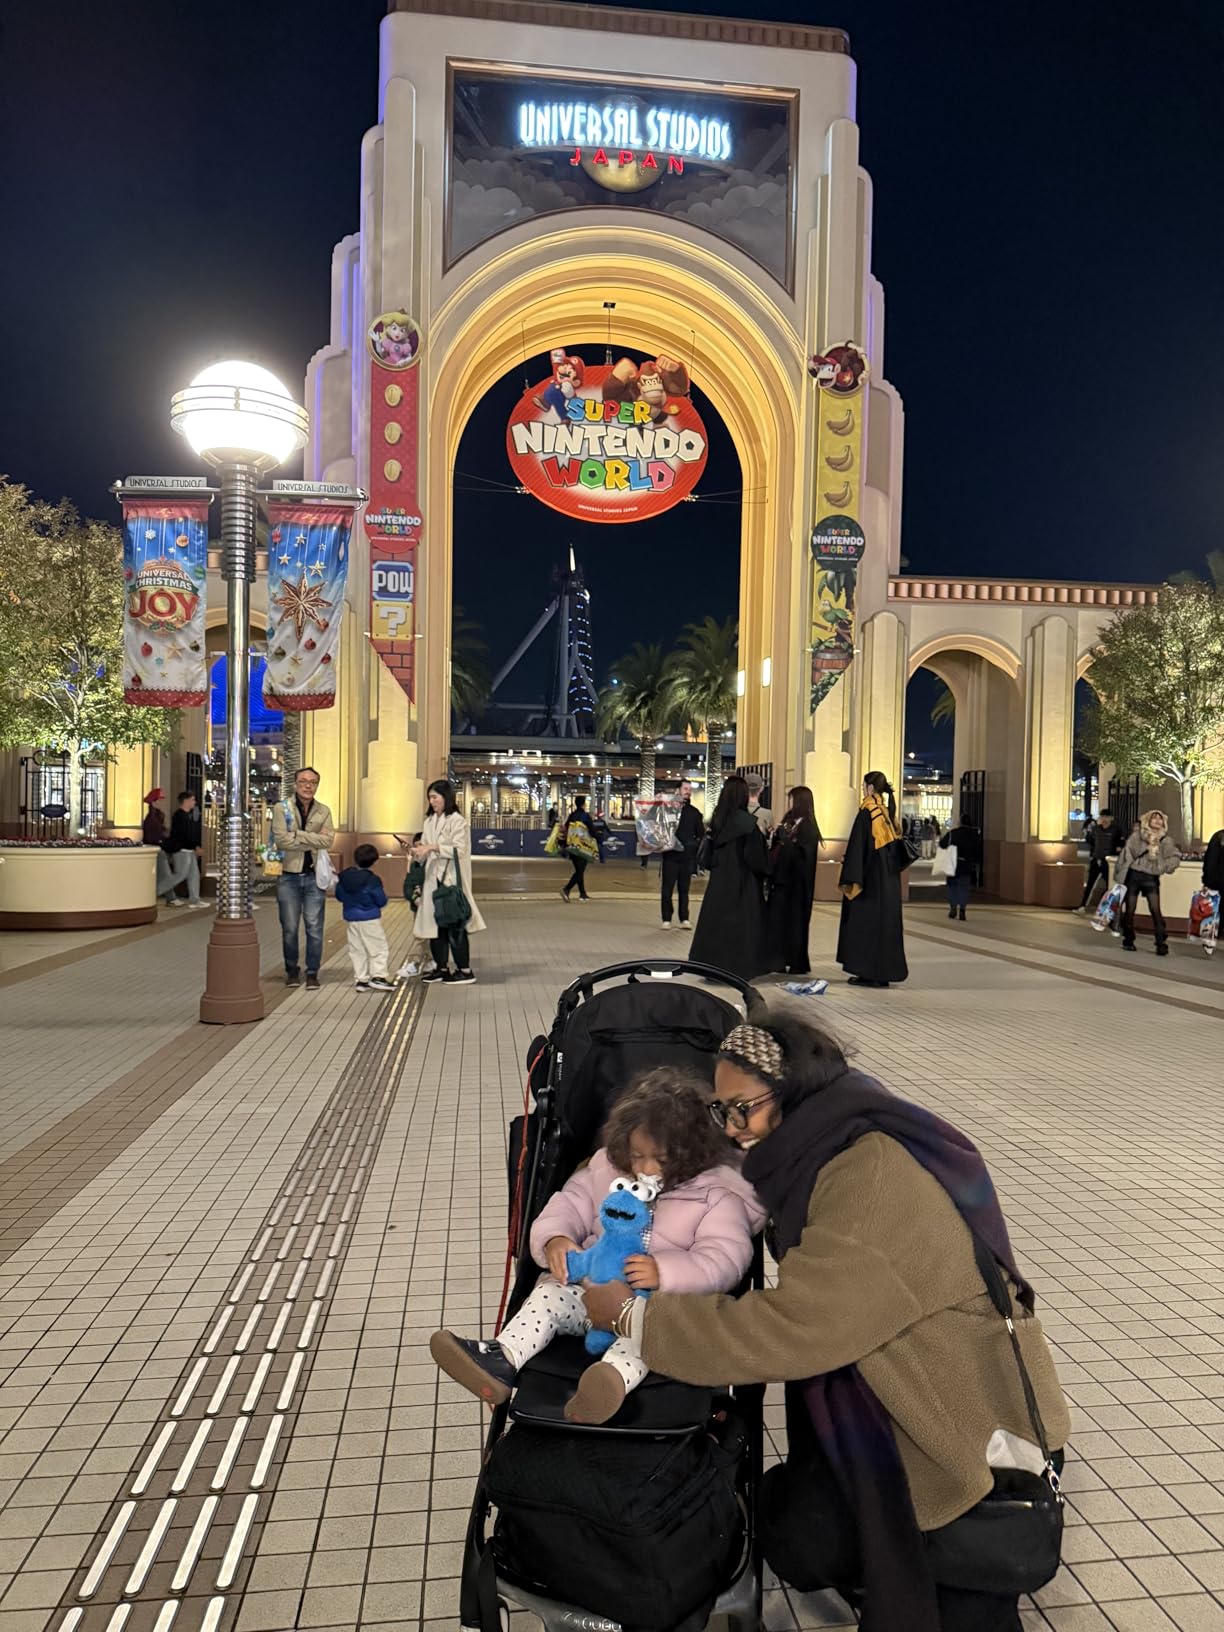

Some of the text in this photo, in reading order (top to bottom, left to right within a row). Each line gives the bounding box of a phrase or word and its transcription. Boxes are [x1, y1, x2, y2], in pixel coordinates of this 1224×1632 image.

[519, 102, 732, 160] UNIVERSAL STUDIOS
[569, 147, 685, 175] JAPAN
[567, 398, 652, 424] SUPER
[511, 421, 705, 462] NINTENDO
[130, 479, 202, 488] UNIVERSAL STUDIOS
[541, 457, 675, 492] WORLD
[278, 482, 348, 494] UNIVERSAL STUDIOS
[365, 514, 421, 526] NINTENDO
[812, 535, 865, 546] NINTENDO
[820, 545, 856, 555] WORLD
[137, 569, 191, 580] UNIVERSAL
[372, 570, 414, 593] POW
[128, 589, 200, 621] JOY
[380, 606, 406, 637] ?
